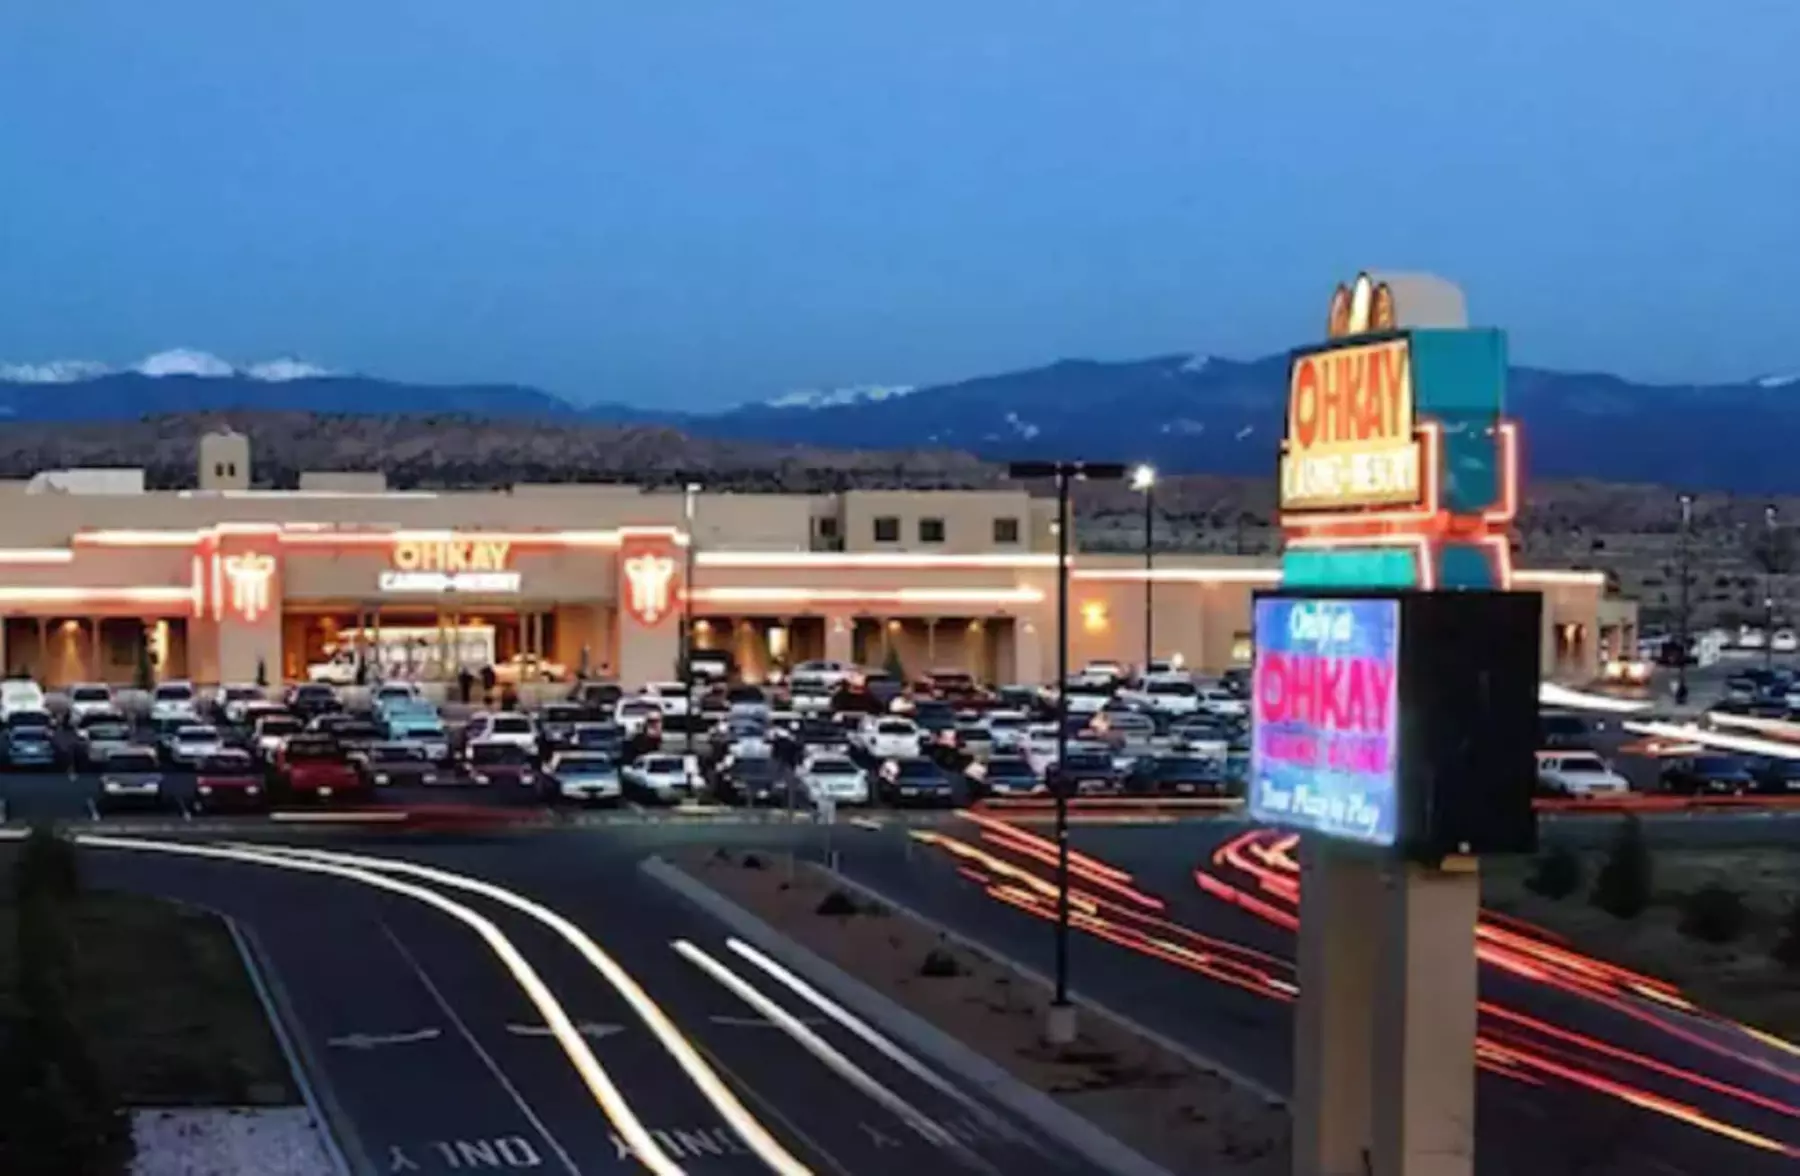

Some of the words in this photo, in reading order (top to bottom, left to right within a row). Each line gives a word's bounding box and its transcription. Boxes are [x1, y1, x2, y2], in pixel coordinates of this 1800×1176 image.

[1297, 349, 1405, 447] OHKAY
[393, 540, 510, 570] OHKAY
[1260, 653, 1393, 732] OHKAY
